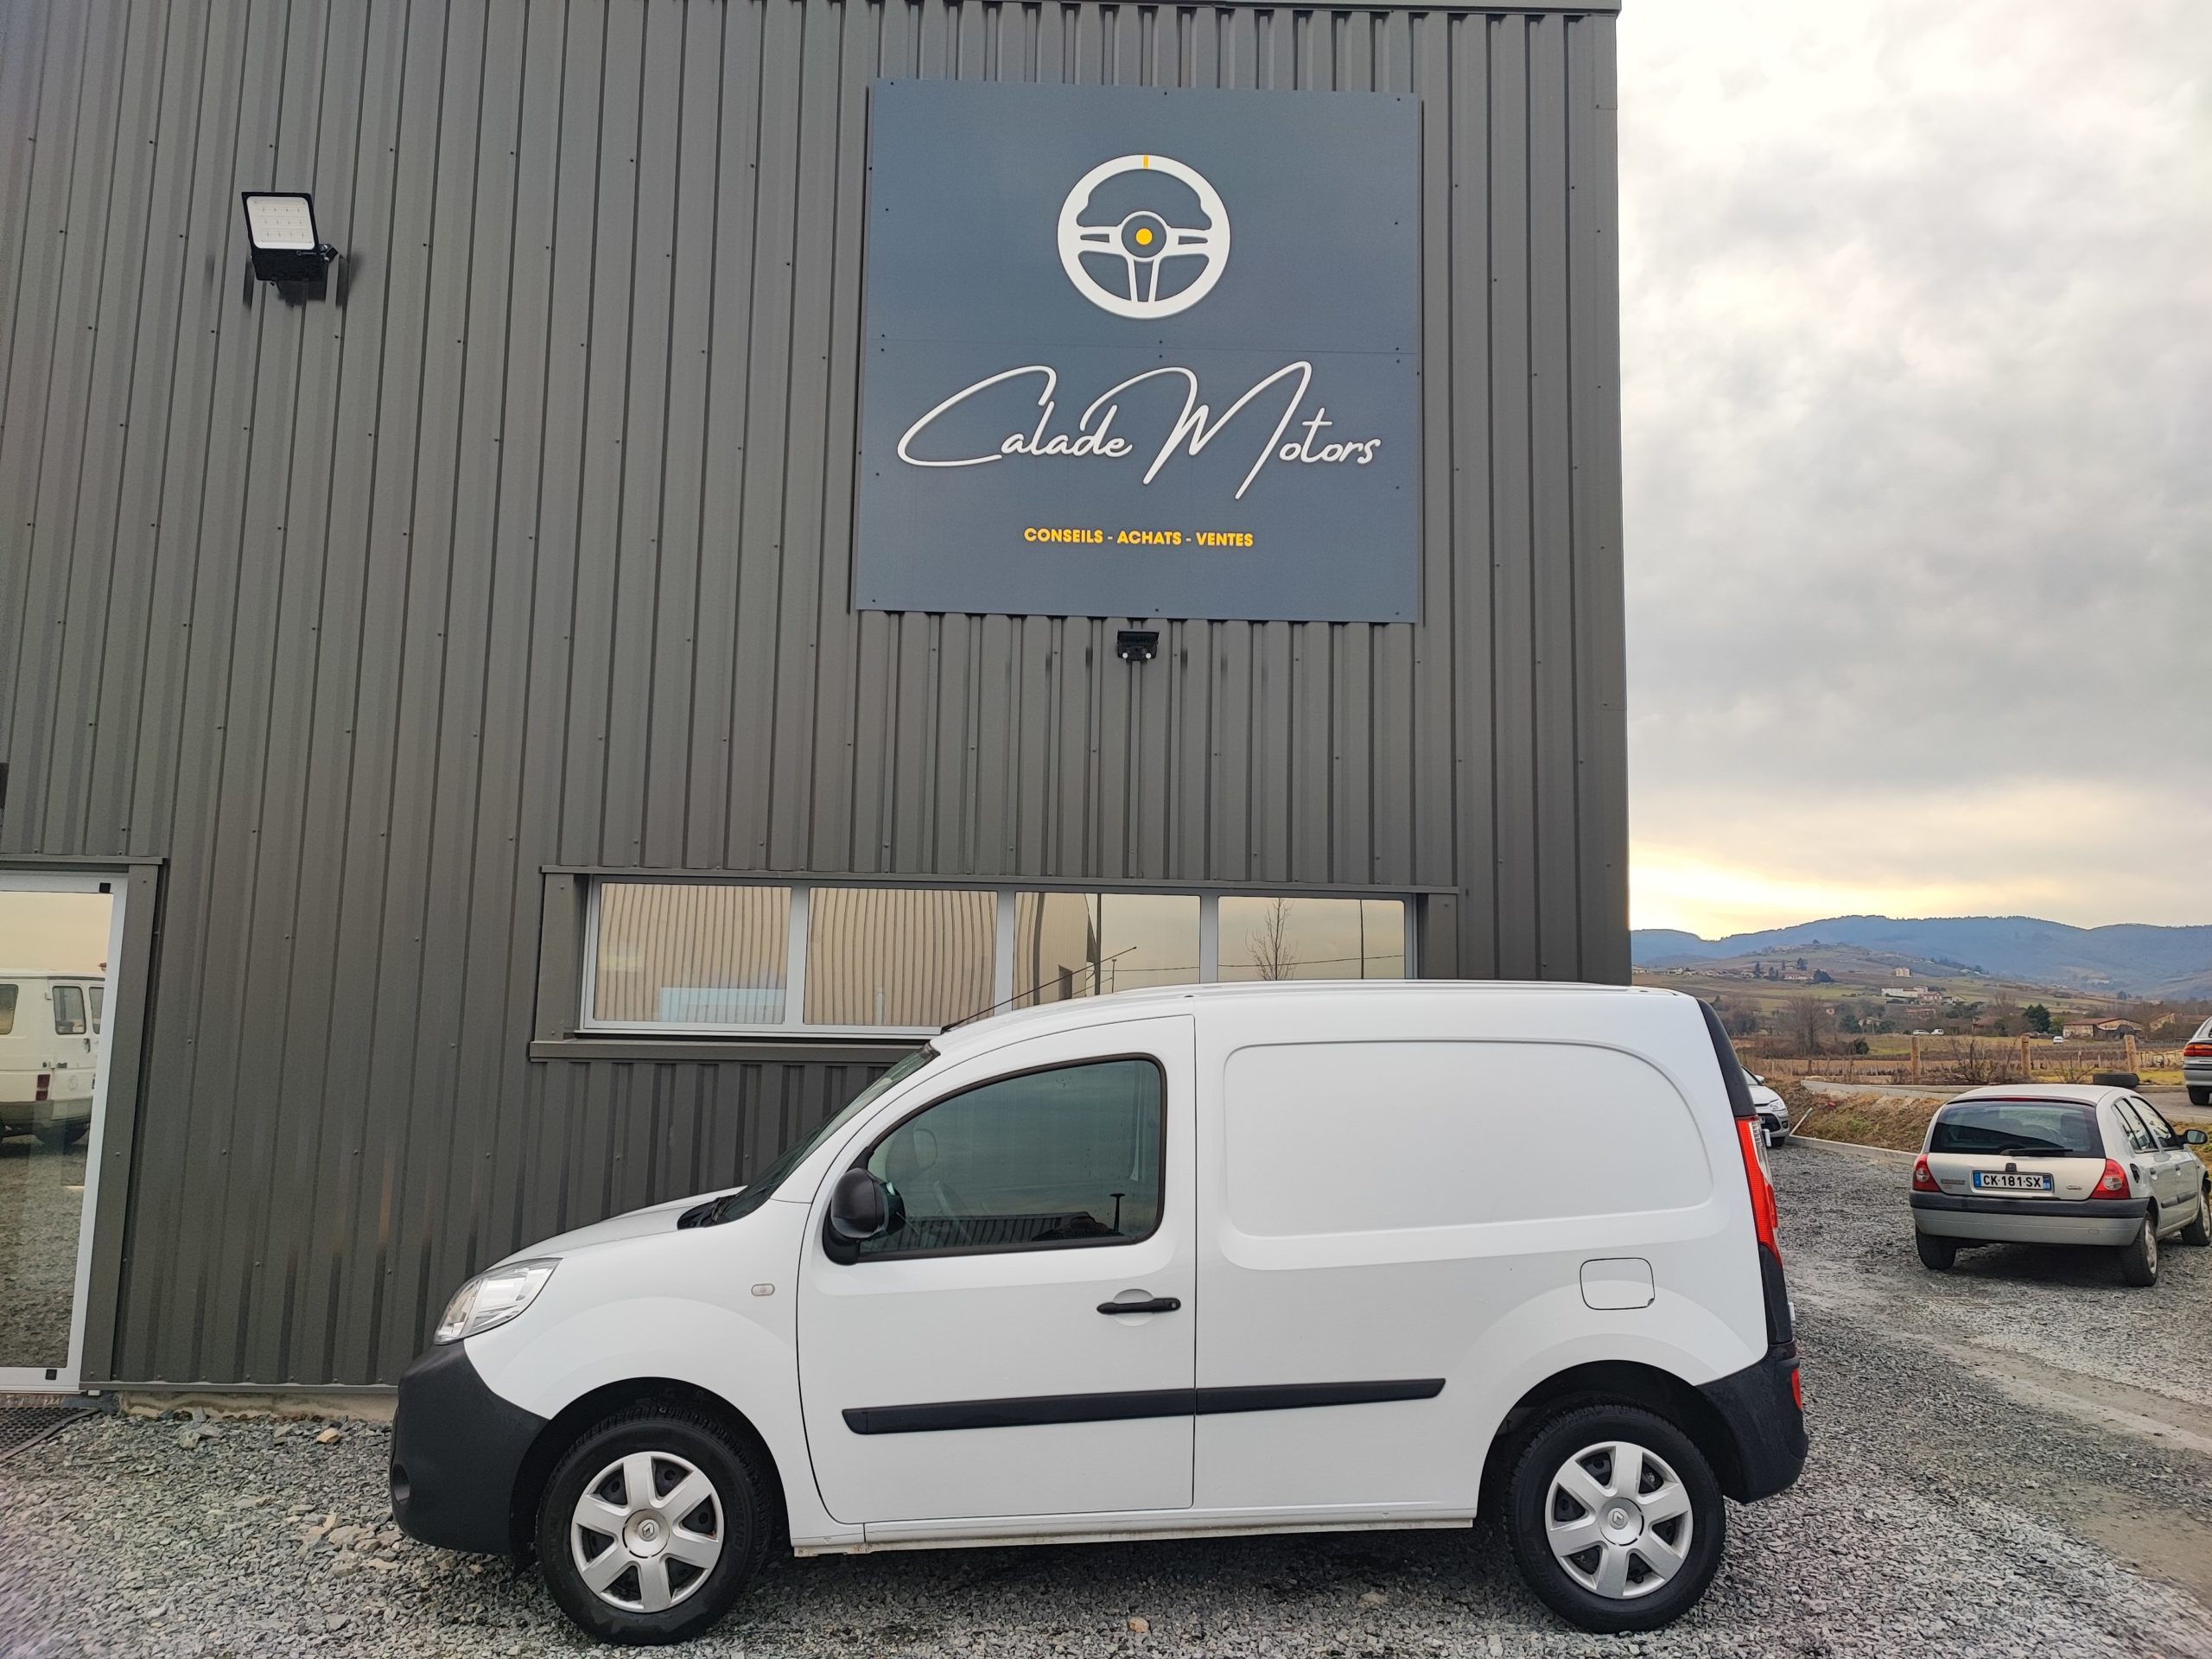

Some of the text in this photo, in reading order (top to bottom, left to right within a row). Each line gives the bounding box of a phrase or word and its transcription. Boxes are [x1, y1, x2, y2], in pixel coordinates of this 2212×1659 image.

[897, 360, 1382, 500] Calade Motors
[1023, 527, 1104, 544] CONSEILS
[1116, 530, 1182, 546] ACHATS
[1196, 531, 1254, 548] VENTES
